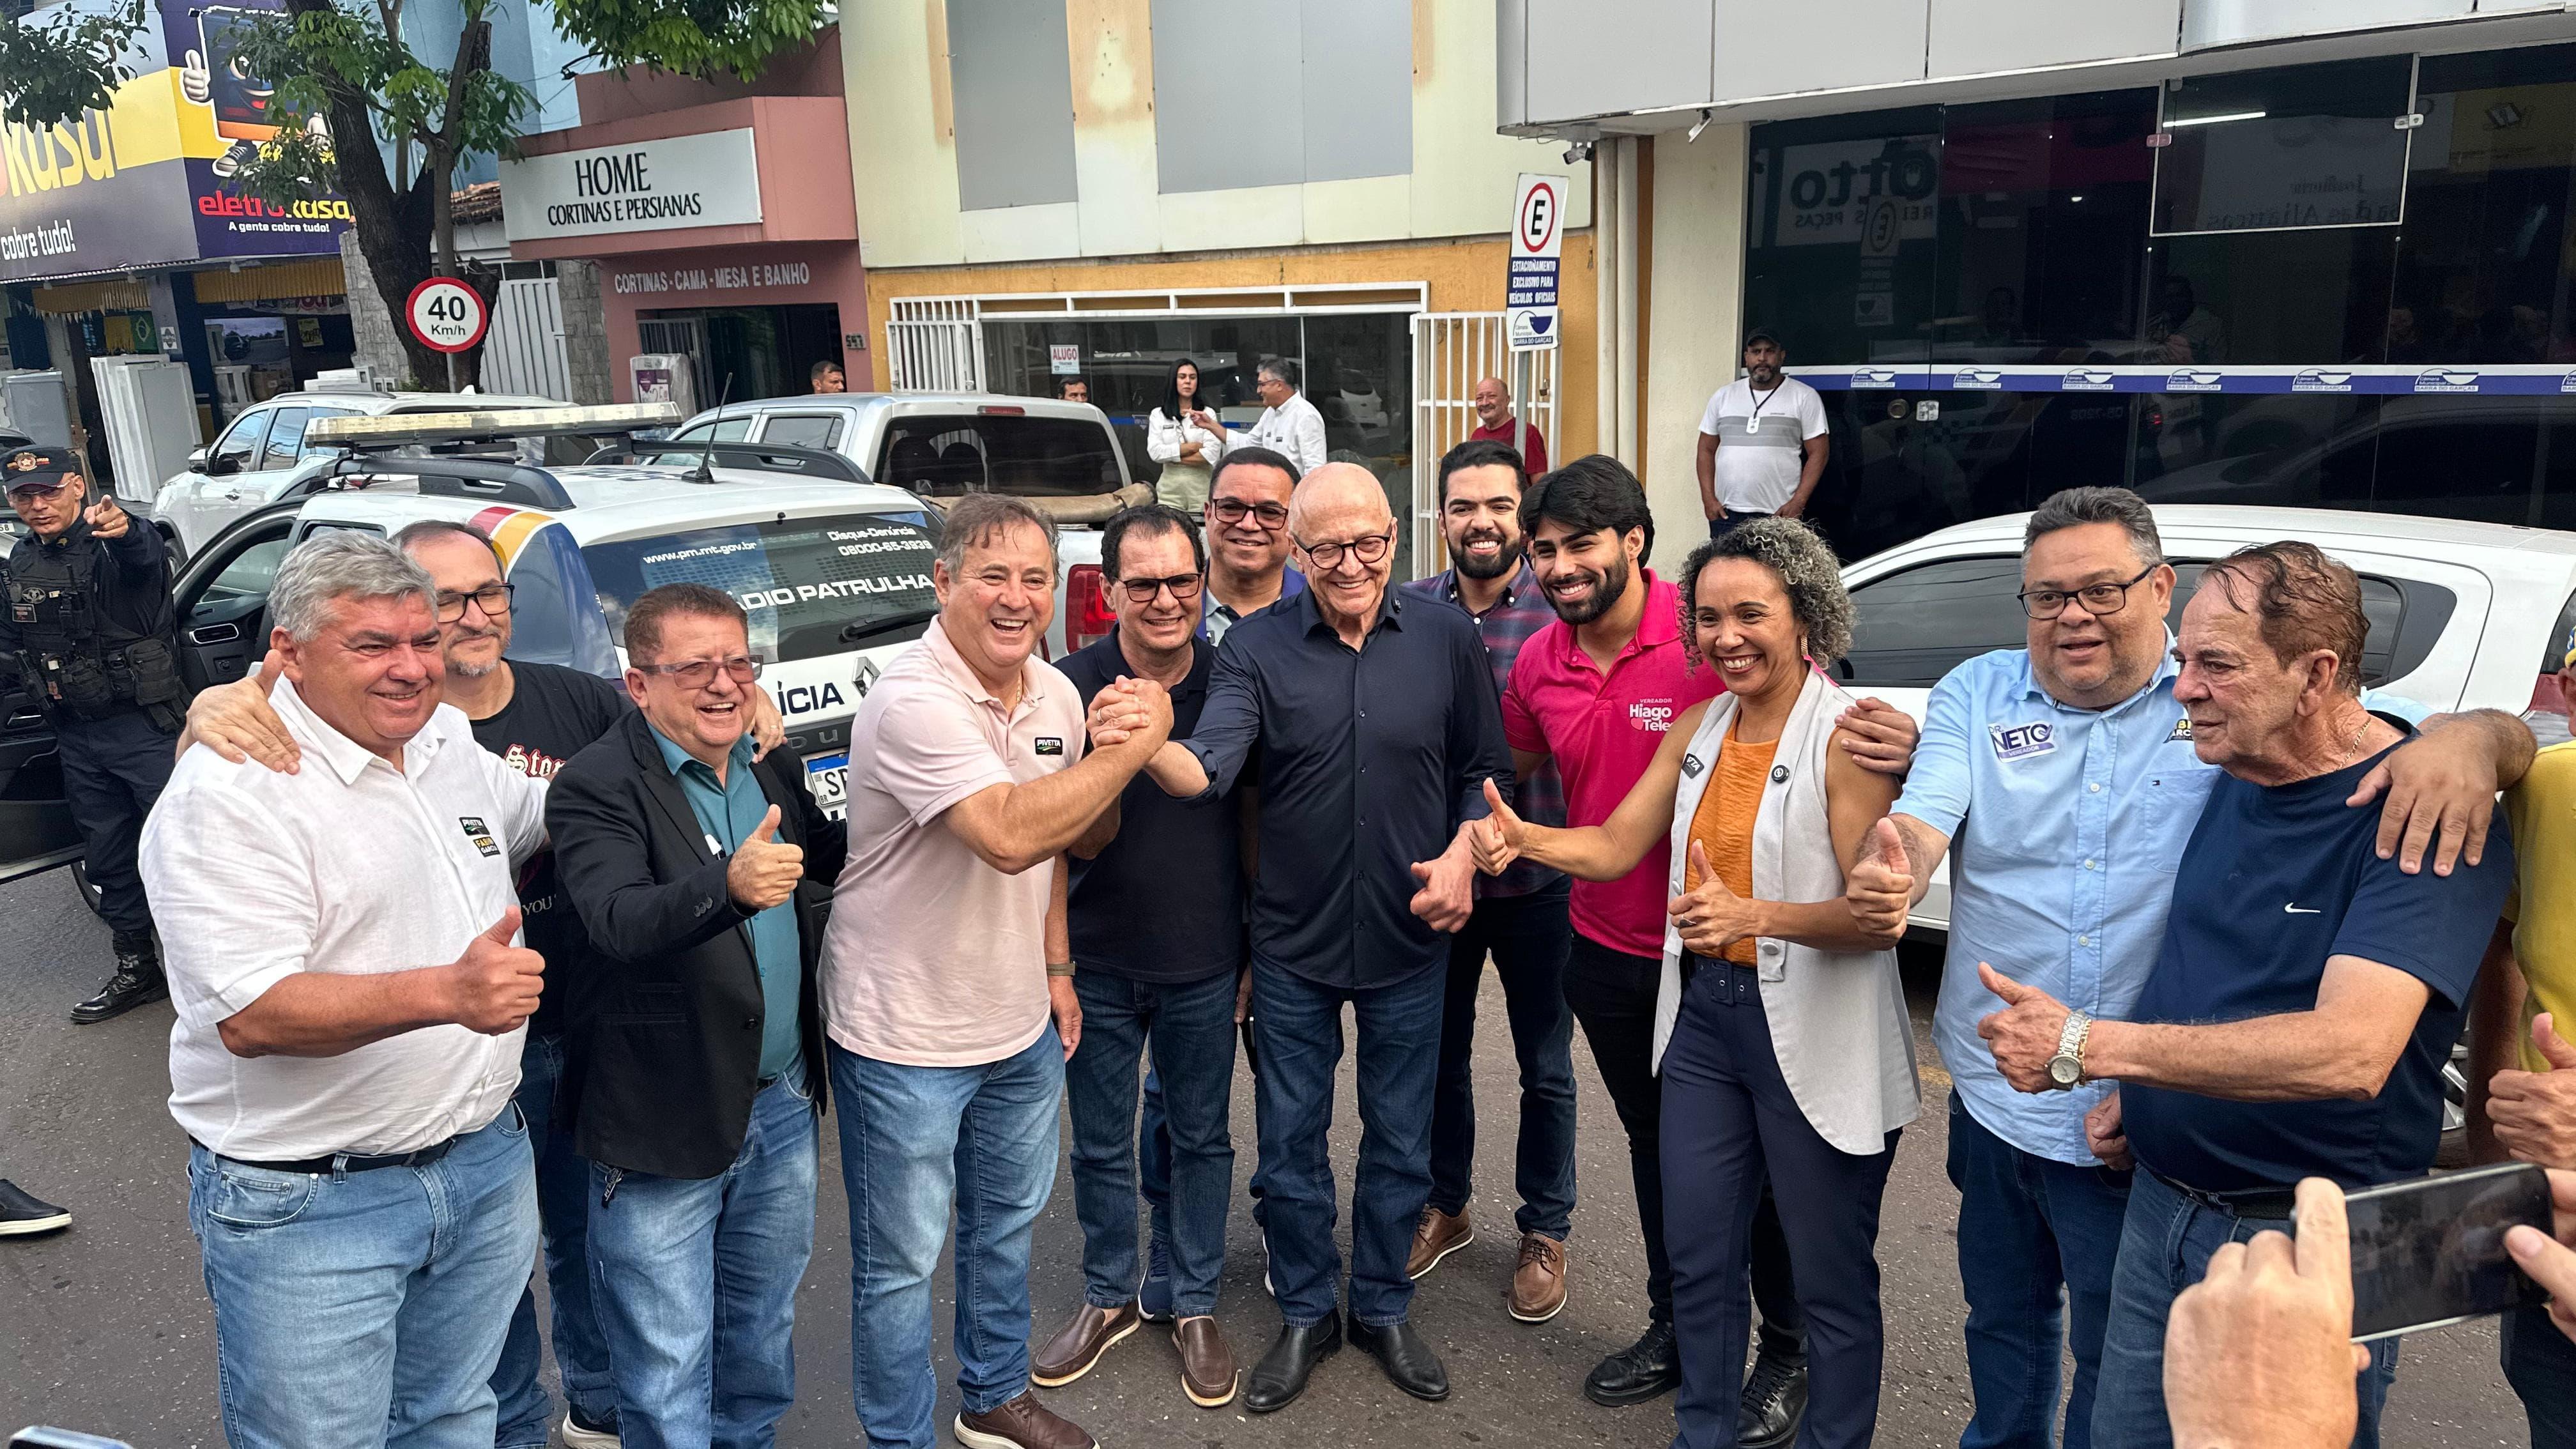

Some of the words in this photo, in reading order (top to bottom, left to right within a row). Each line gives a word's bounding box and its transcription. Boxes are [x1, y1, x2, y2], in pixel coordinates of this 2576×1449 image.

[575, 152, 651, 196] HOME
[548, 201, 611, 226] CORTINAS
[615, 200, 624, 220] E
[626, 193, 702, 219] PERSIANAS
[1531, 200, 1545, 235] E
[229, 222, 237, 231] A
[238, 224, 268, 233] gente
[271, 224, 301, 233] cobre
[303, 223, 330, 233] tudo!
[1, 227, 38, 260] cobre
[38, 219, 76, 256] tudo!
[614, 271, 669, 293] CORTINAS
[674, 270, 709, 291] CAMA
[714, 266, 749, 288] MESA
[751, 266, 762, 286] E
[763, 262, 810, 286] BANHO
[1512, 276, 1540, 288] EXCLUSIVO
[1540, 276, 1554, 288] PARA
[1509, 290, 1533, 304] VEÍCULOS
[1535, 291, 1556, 303] OFICIAIS
[427, 296, 466, 321] 40
[431, 324, 466, 335] Km/h
[1052, 348, 1077, 360] ALUGO
[827, 526, 917, 540] Disque-Denúncia
[643, 542, 757, 564] www.pm.mt.gov.br
[838, 540, 933, 556] 08000-65-3939
[797, 574, 935, 601] PATRULHA
[778, 680, 845, 716] ÍCIA
[1629, 703, 1673, 721] Hiago
[1642, 719, 1674, 732] Tele
[1991, 724, 2051, 751] NETO
[505, 745, 565, 776] Stor
[2008, 746, 2040, 756] VEREADOR
[819, 794, 829, 804] BR
